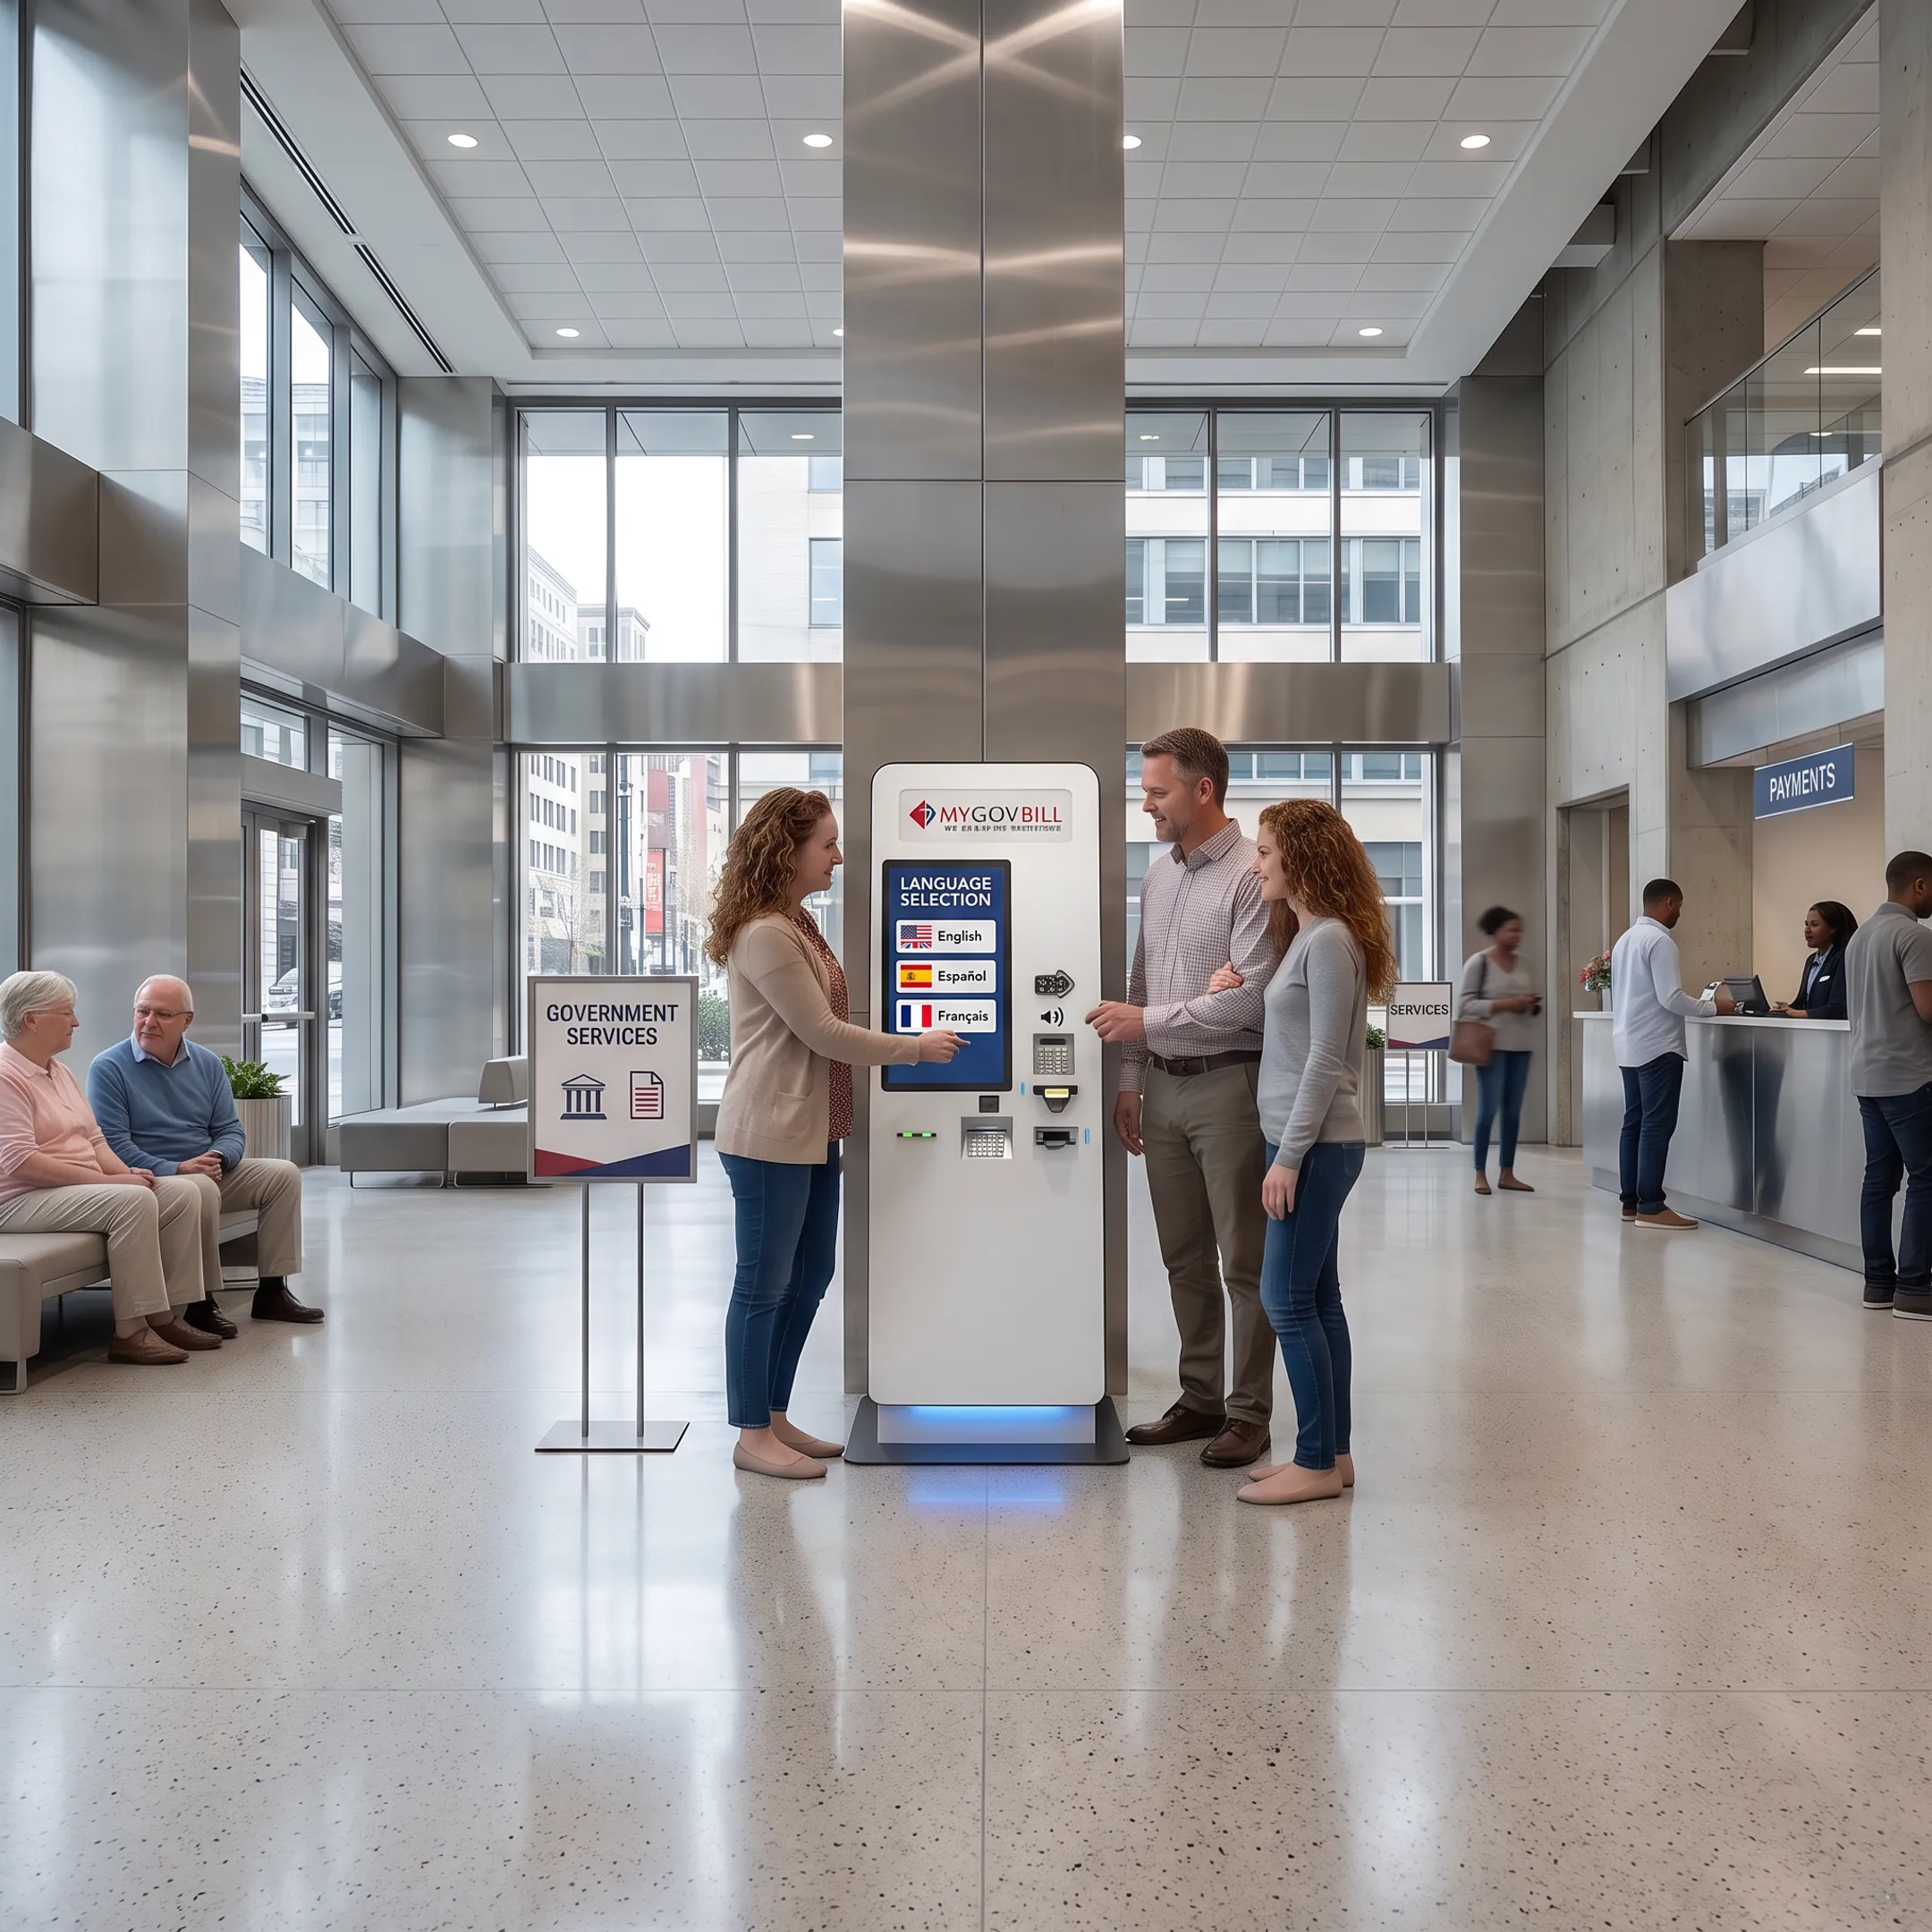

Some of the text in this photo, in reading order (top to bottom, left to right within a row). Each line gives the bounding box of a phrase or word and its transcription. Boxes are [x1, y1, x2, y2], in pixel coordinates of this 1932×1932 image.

[1769, 762, 1835, 802] PAYMENTS
[940, 806, 1063, 823] MYGOVBILL
[900, 877, 992, 891] LANGUAGE
[900, 893, 991, 907] SELECTION
[938, 930, 982, 944] English
[938, 970, 987, 984] Español
[547, 1004, 679, 1022] GOVERNMENT
[1390, 1004, 1449, 1015] SERVICES
[938, 1010, 989, 1024] Français
[566, 1027, 658, 1045] SERVICES
